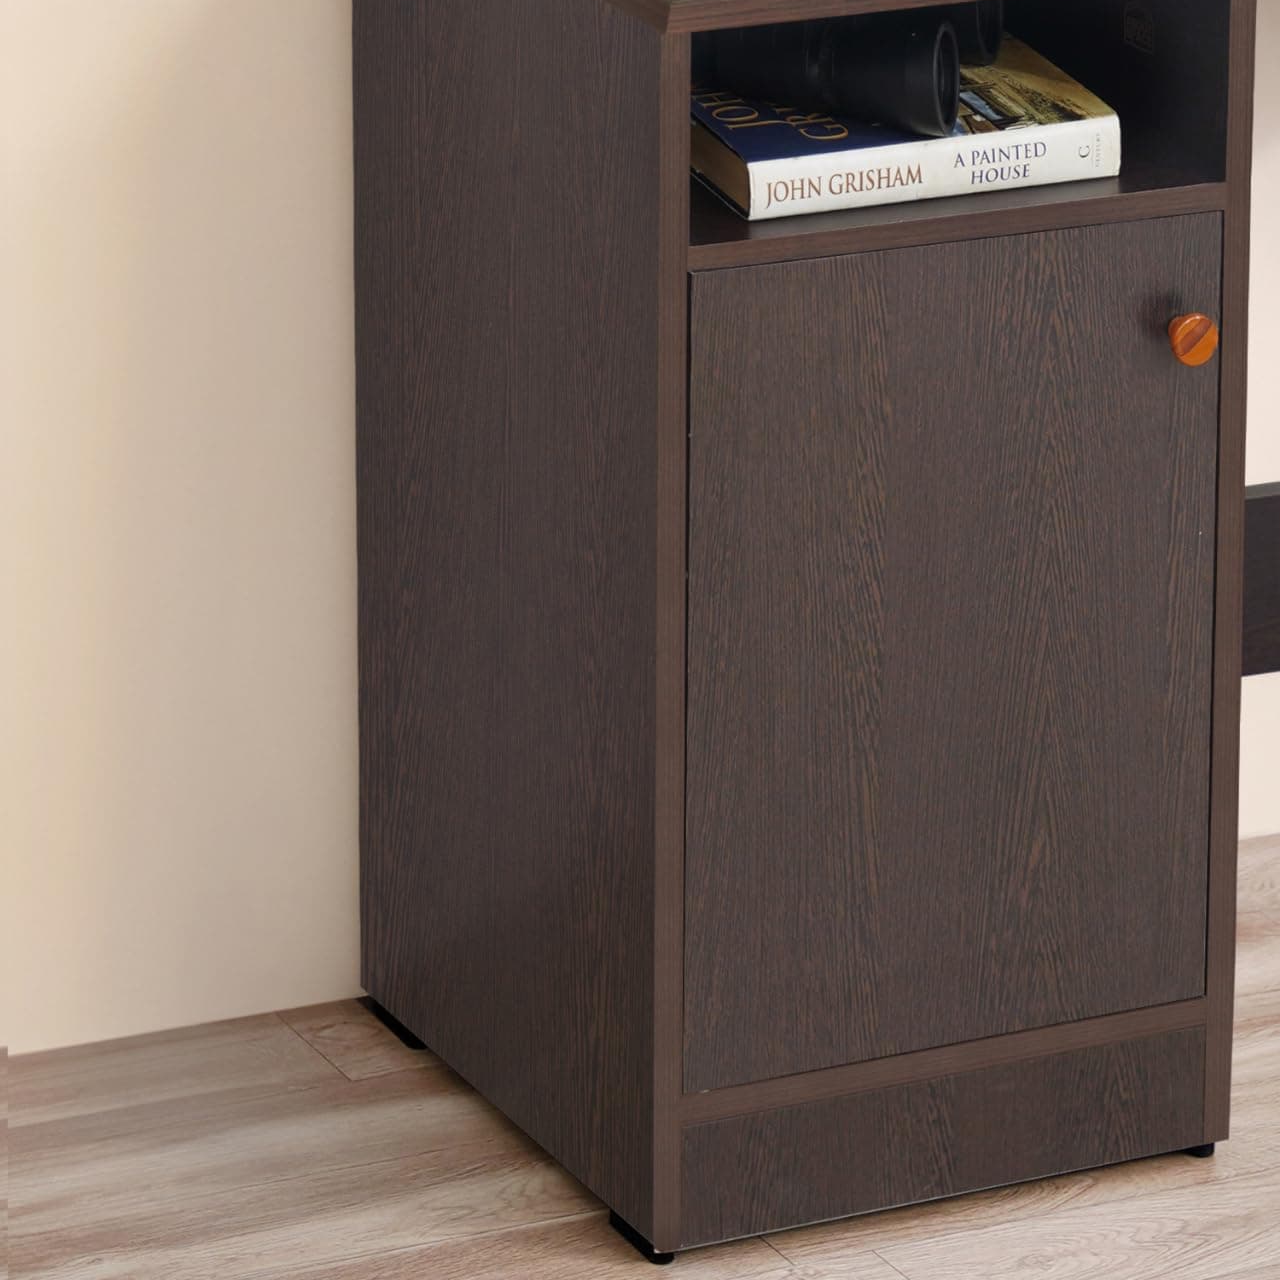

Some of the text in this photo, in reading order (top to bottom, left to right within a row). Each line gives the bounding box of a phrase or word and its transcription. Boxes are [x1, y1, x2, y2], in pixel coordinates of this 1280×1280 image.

[953, 140, 1048, 169] A PAINTED
[765, 163, 924, 210] JOHN GRISHAM
[970, 164, 1031, 186] HOUSE
